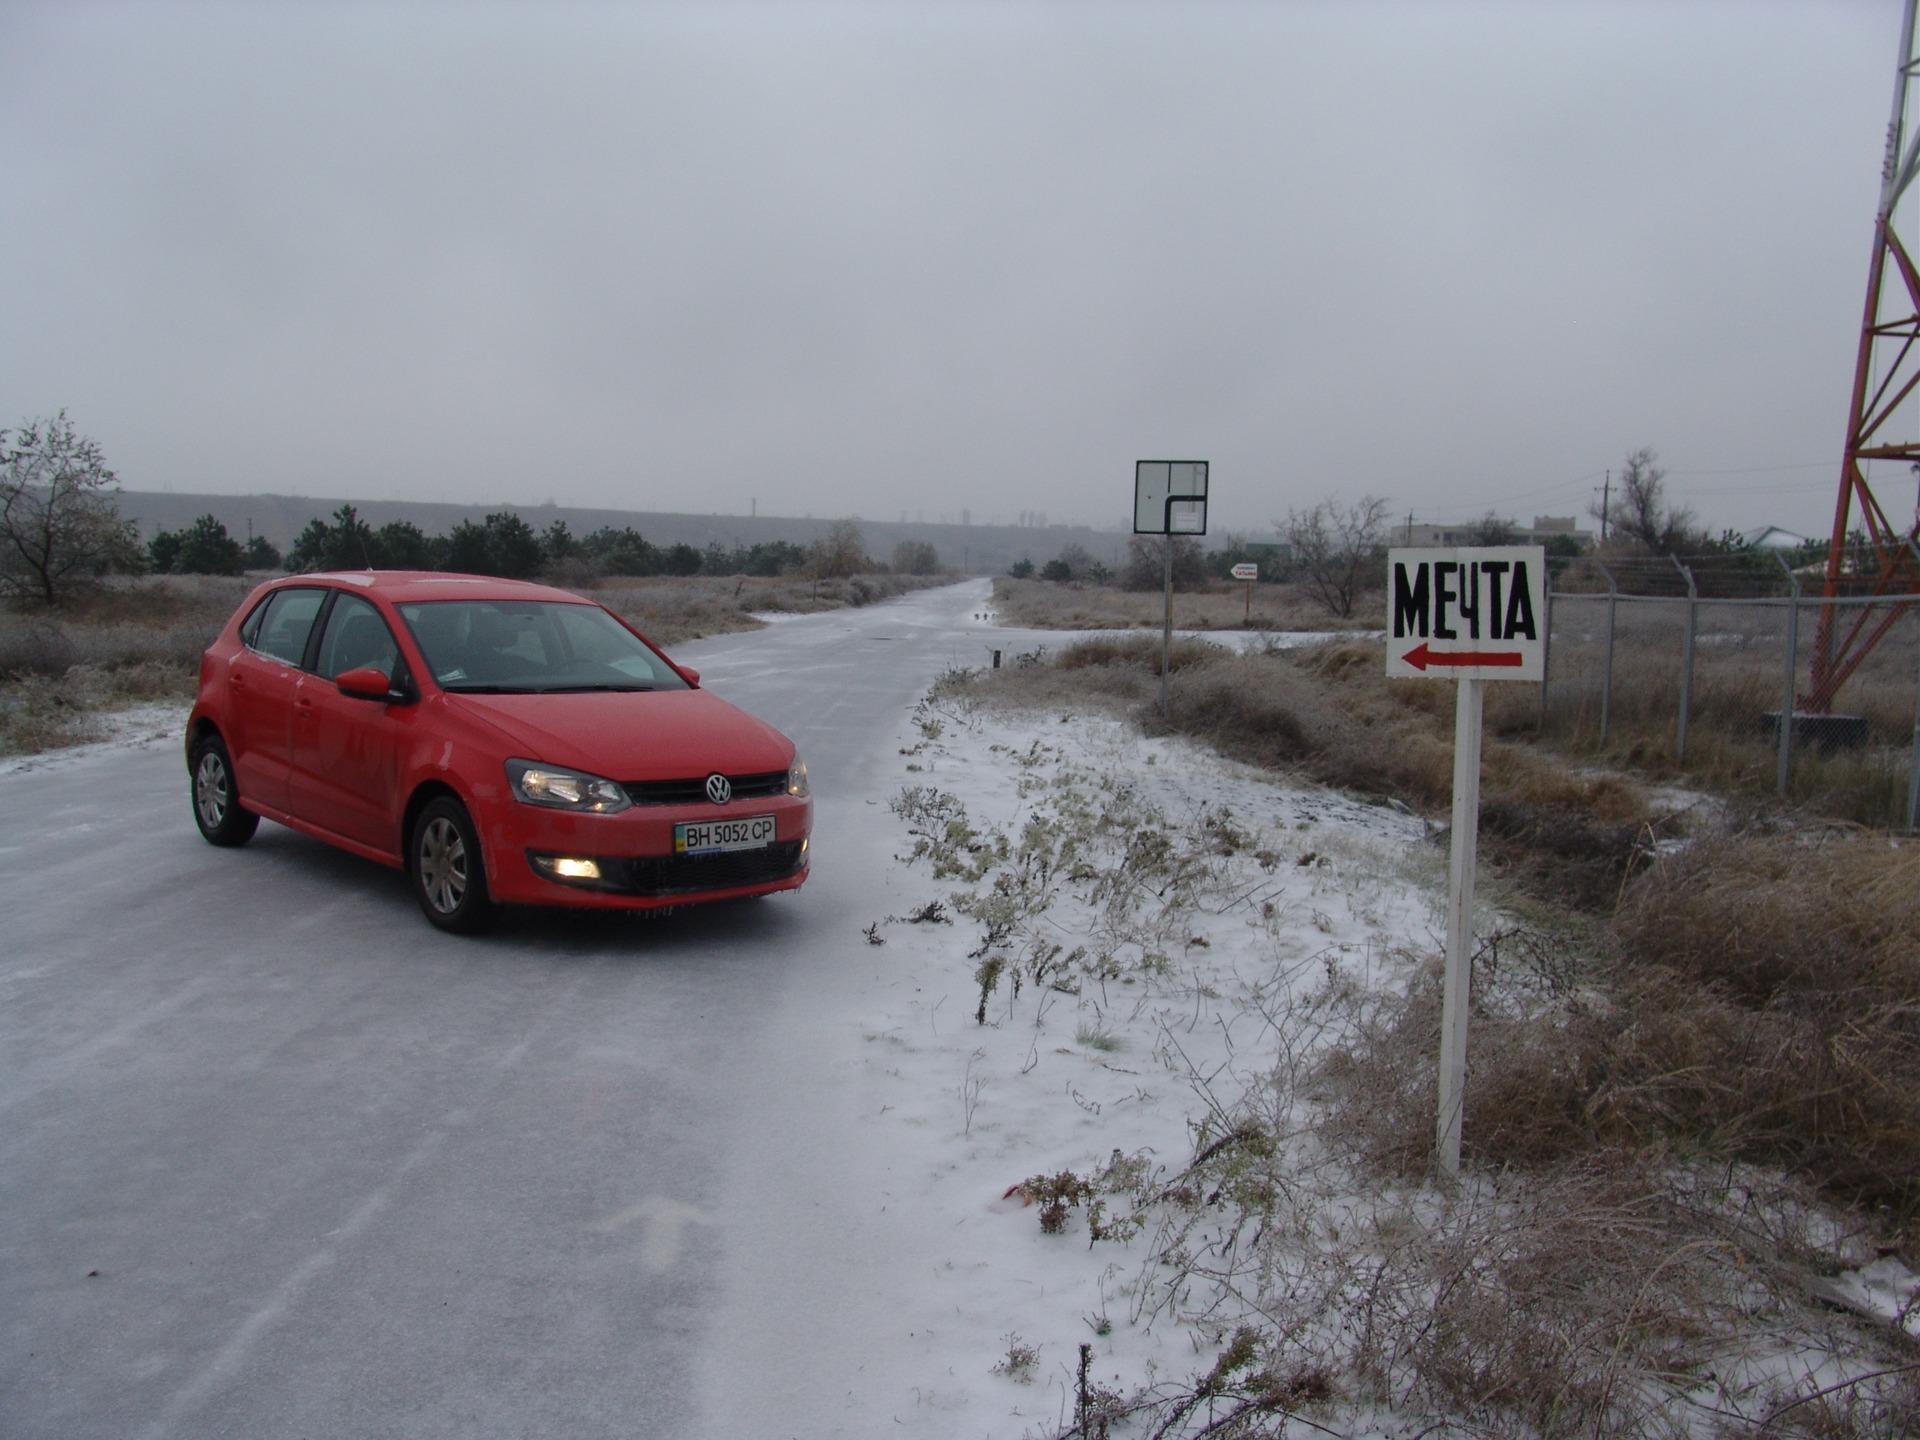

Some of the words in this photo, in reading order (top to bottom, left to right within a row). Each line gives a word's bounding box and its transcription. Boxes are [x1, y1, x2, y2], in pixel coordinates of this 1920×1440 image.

[1394, 561, 1536, 640] МЕЧТА
[687, 827, 710, 847] BH
[714, 823, 748, 844] 5052
[752, 820, 772, 839] CP
